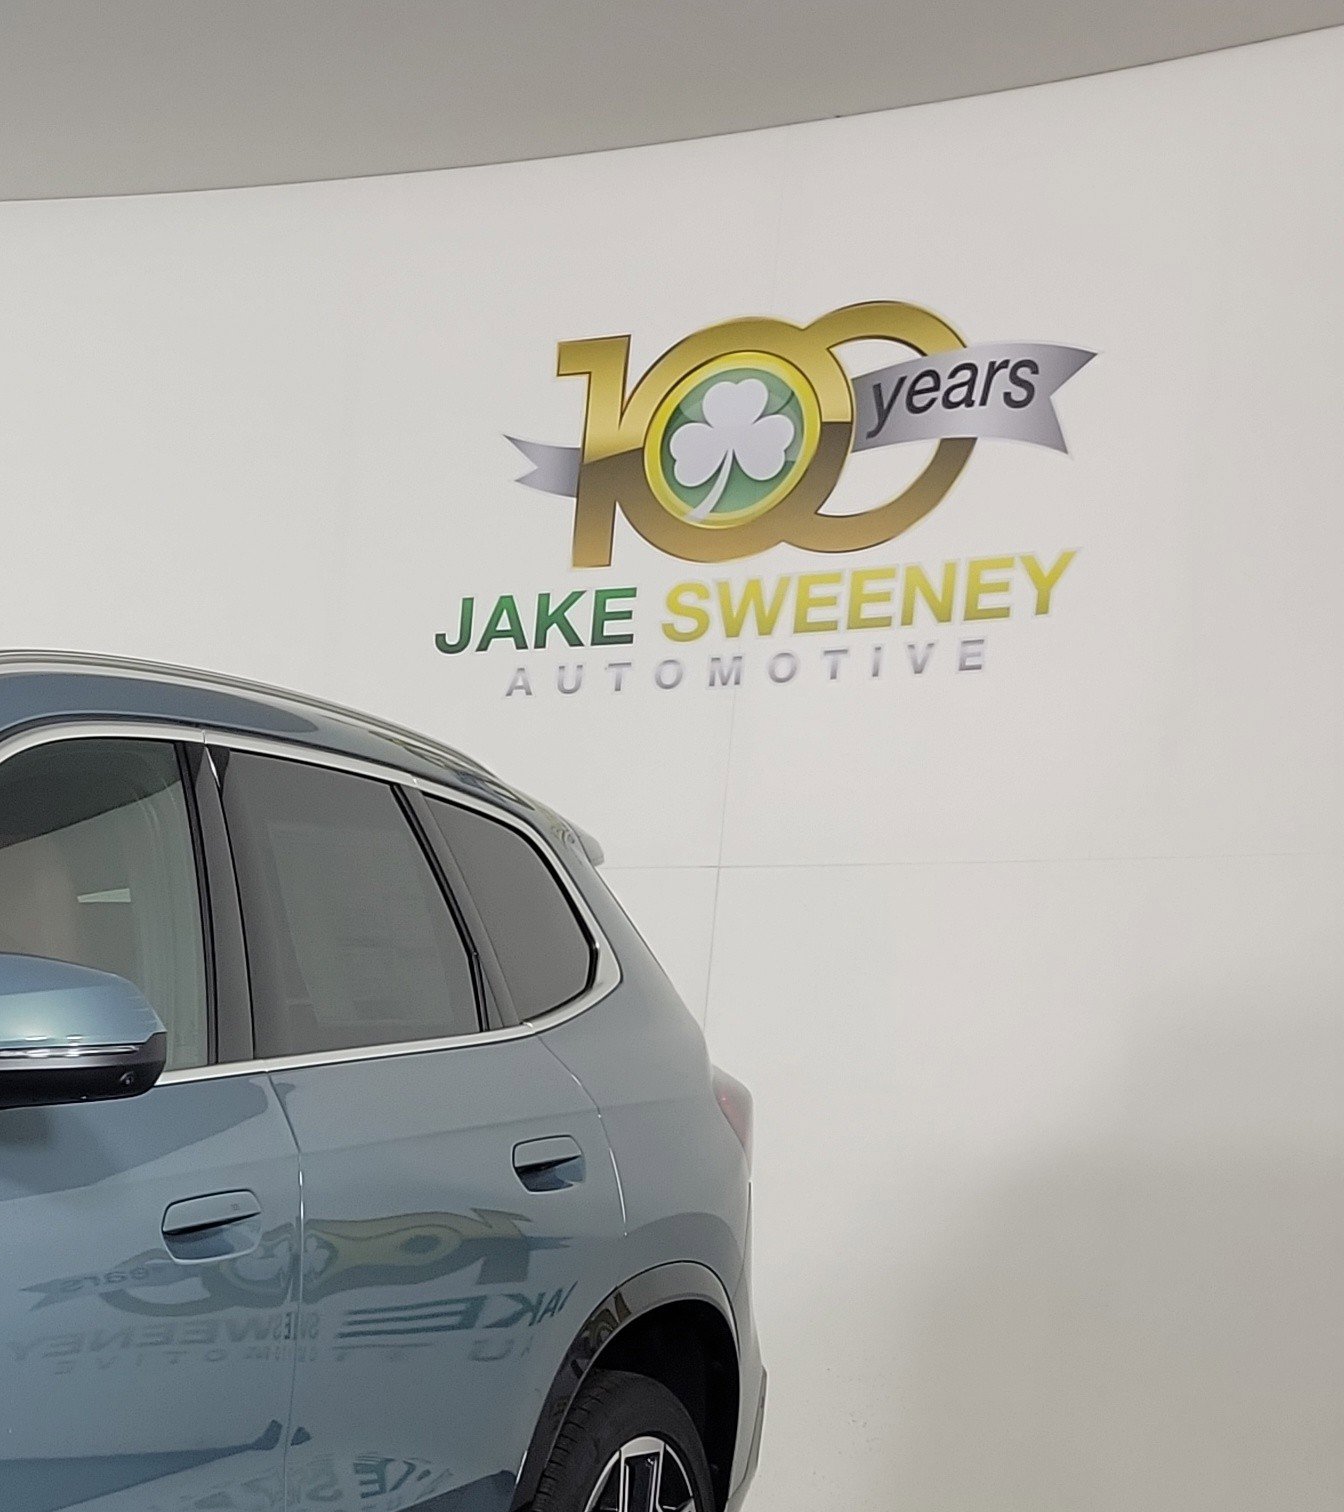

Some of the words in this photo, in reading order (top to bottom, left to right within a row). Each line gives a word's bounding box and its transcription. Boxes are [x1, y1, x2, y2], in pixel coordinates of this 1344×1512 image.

[556, 300, 977, 569] 100
[865, 356, 1040, 439] years
[433, 586, 637, 655] JAKE
[660, 549, 1078, 643] SWEENEY
[505, 638, 986, 697] AUTOMOTIVE
